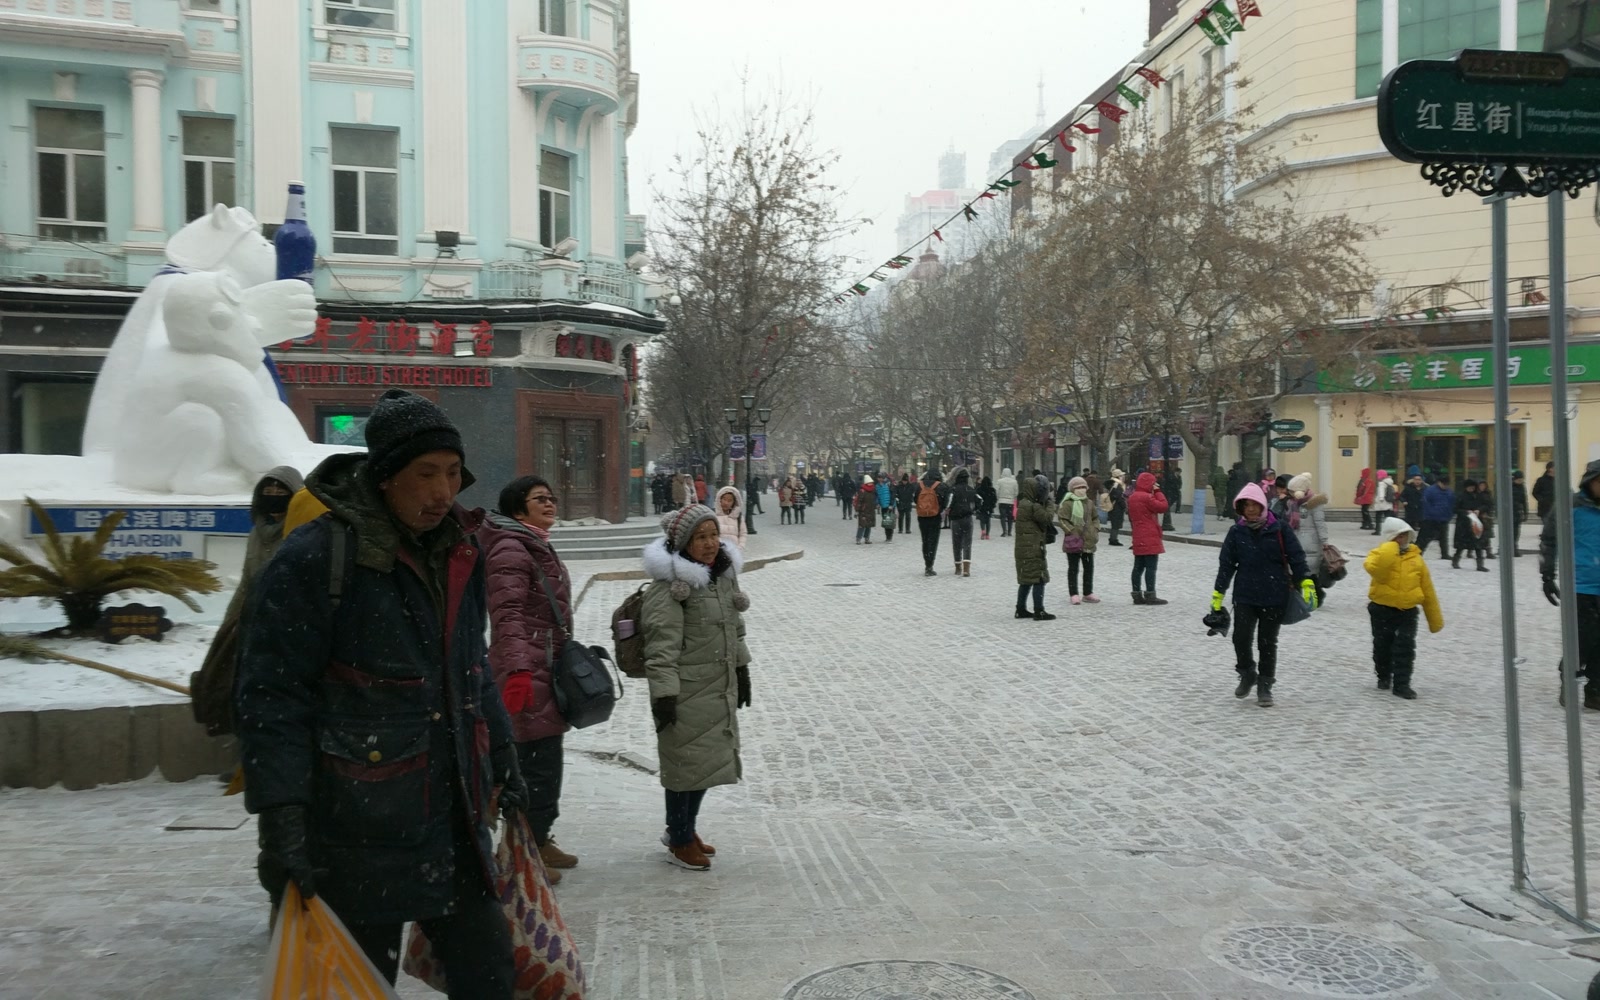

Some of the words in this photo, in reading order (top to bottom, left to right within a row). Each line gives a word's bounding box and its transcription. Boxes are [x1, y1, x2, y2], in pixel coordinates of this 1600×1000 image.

[1416, 99, 1512, 134] 红星街
[278, 315, 494, 358] 年老街酒店
[277, 364, 340, 384] ENTURY
[346, 364, 377, 385] OLD
[382, 365, 440, 386] STREET
[443, 367, 493, 387] HOTEL
[111, 533, 182, 548] HARBIN
